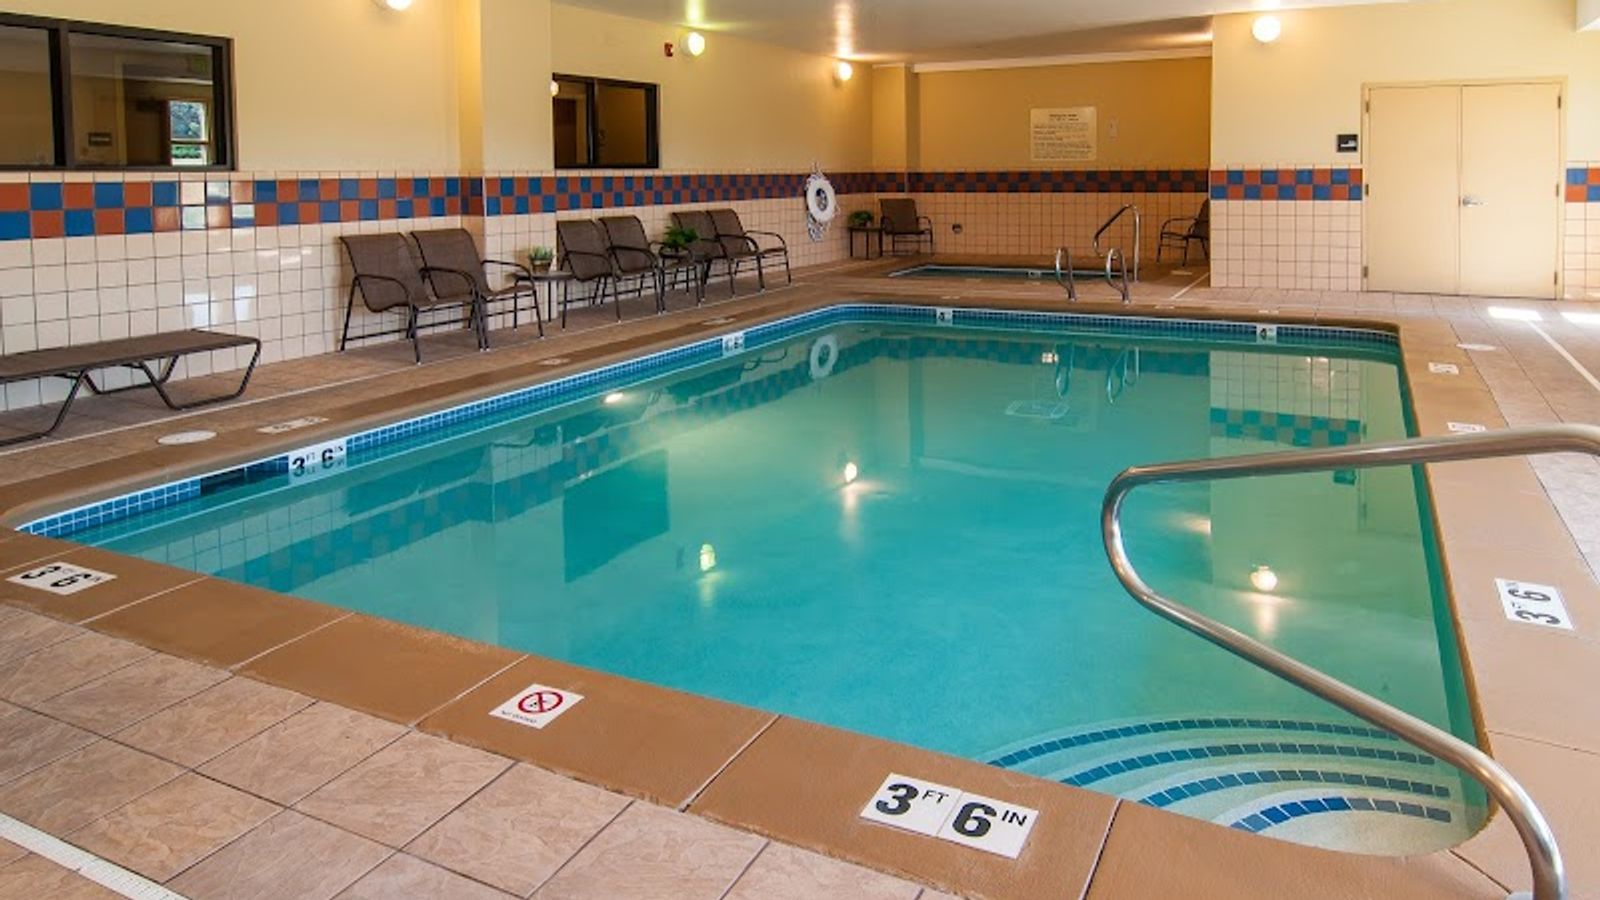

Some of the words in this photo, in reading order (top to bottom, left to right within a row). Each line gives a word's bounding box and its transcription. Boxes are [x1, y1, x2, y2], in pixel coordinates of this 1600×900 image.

[292, 456, 305, 477] 3
[321, 448, 334, 470] 6
[1508, 588, 1552, 602] 6
[1515, 610, 1561, 625] 3
[875, 783, 919, 815] 3
[921, 789, 949, 804] FT
[952, 801, 997, 838] 6
[1001, 809, 1028, 827] IN
